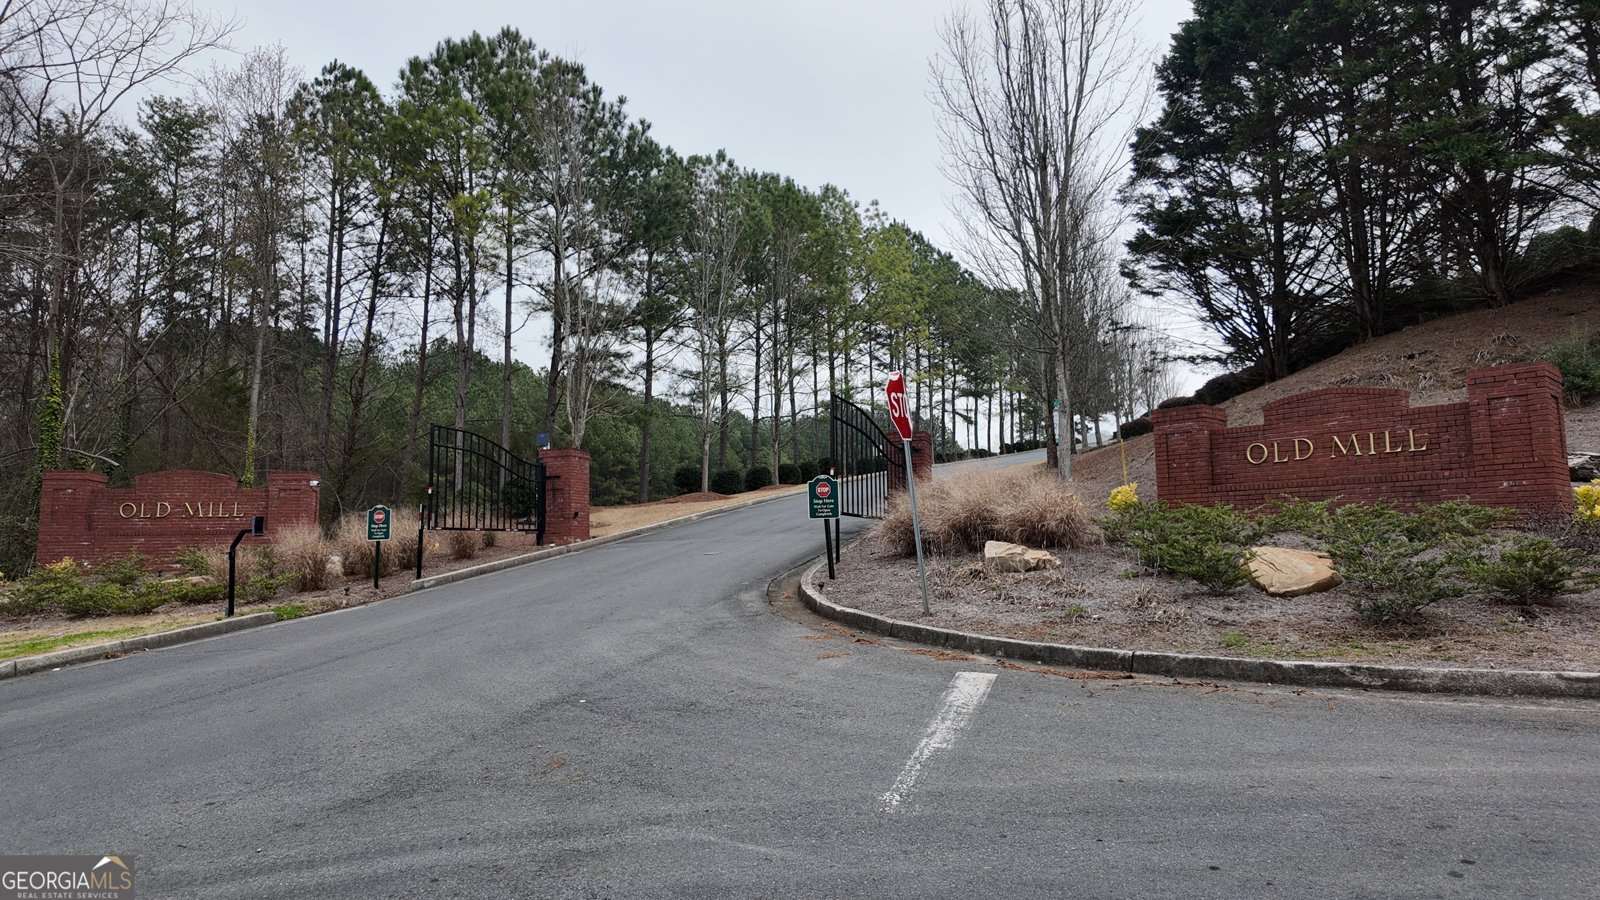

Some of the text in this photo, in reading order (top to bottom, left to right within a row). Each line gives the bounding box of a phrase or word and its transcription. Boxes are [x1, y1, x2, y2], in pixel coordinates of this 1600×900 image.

[890, 392, 910, 418] STO
[1246, 428, 1427, 465] OLD MILL
[119, 501, 246, 519] OLD MILL
